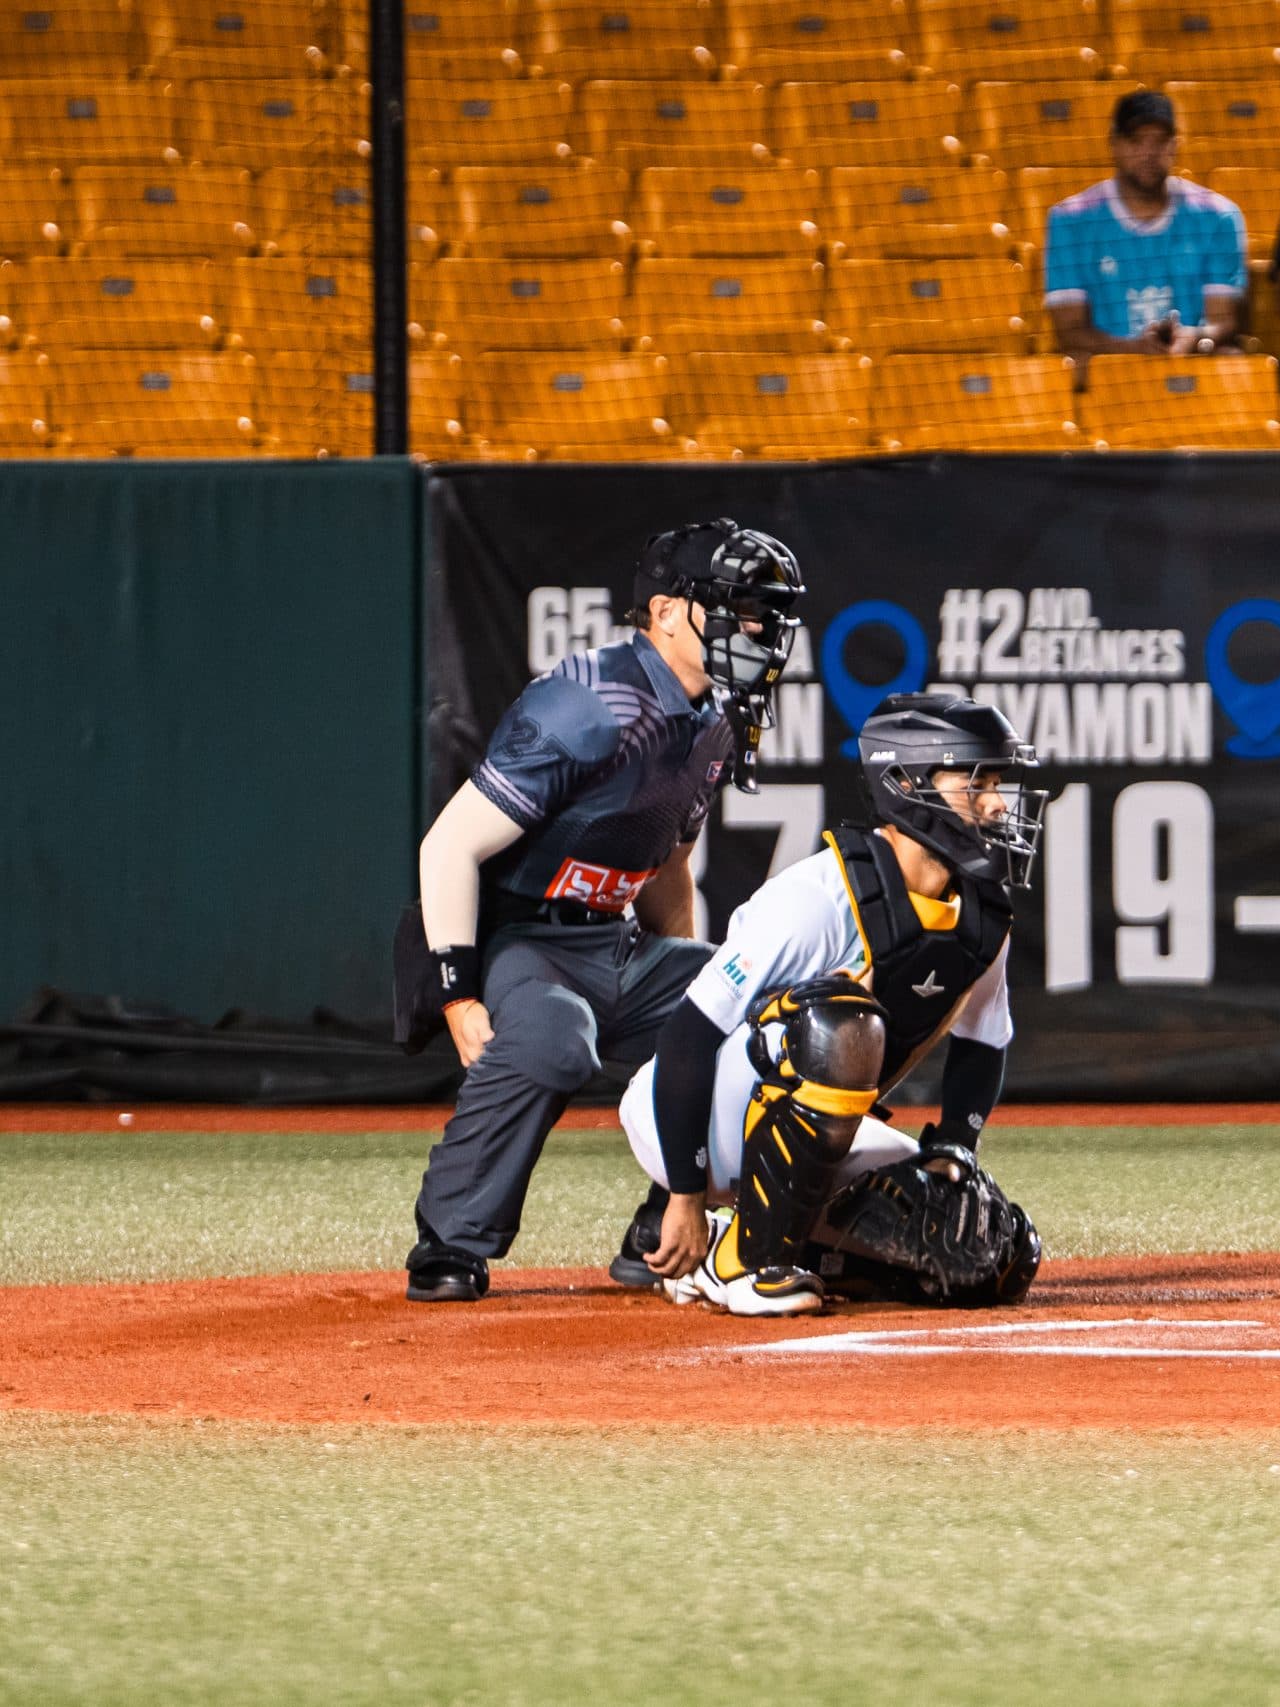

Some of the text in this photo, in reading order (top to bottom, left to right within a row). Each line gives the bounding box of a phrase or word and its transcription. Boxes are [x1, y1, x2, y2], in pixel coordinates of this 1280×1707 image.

[938, 587, 1025, 677] #2
[1020, 629, 1185, 677] BETANCES
[926, 682, 1213, 766] YAMON
